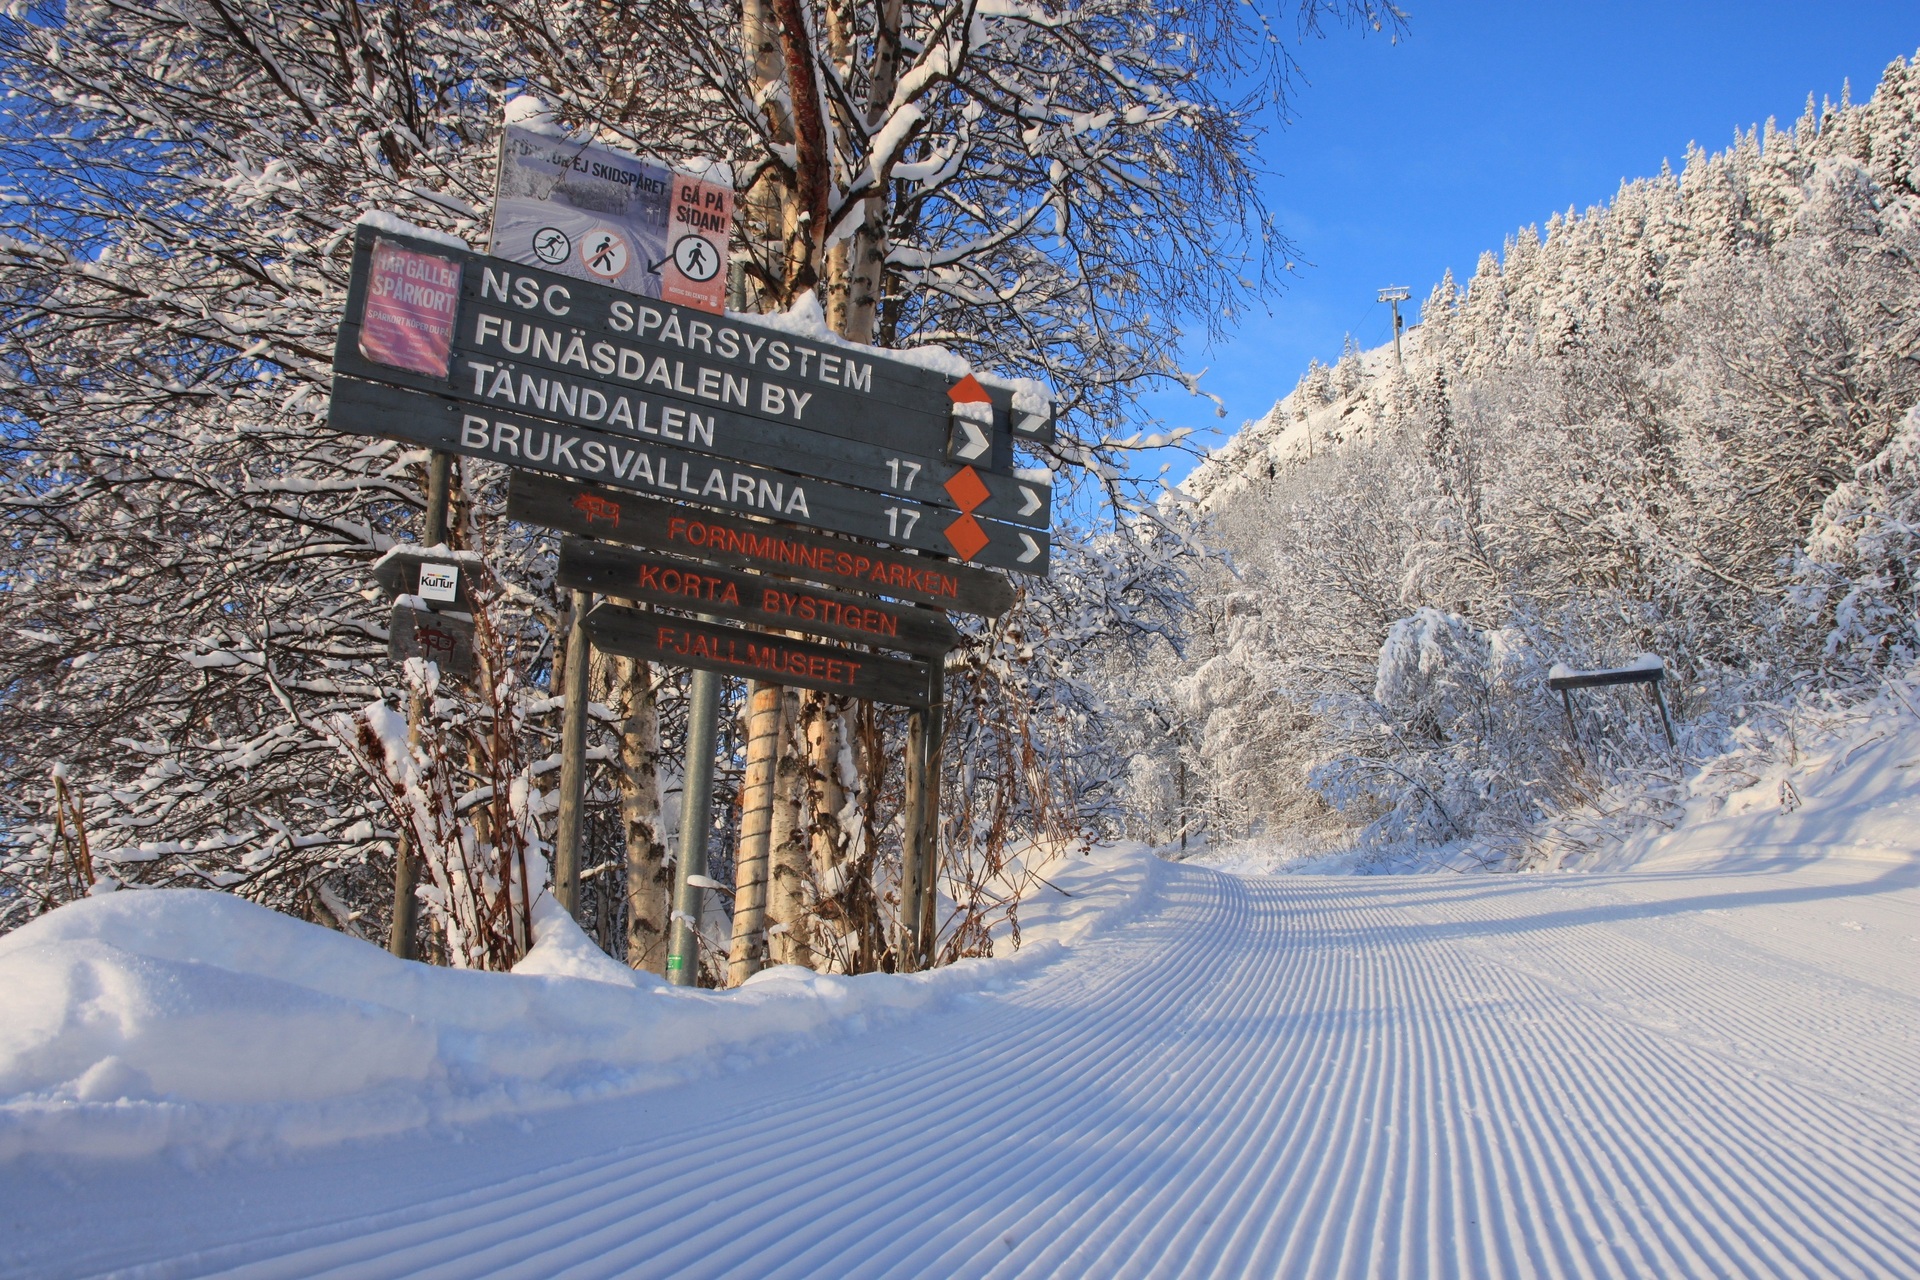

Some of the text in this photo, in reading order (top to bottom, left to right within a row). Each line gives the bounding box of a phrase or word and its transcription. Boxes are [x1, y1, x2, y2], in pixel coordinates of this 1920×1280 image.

[573, 157, 589, 173] EJ
[592, 162, 667, 196] SKIDSPÅRET
[681, 185, 724, 212] GÅ PÅ
[676, 205, 725, 233] SIDAN!
[372, 276, 455, 314] SPÅRKORT
[406, 259, 458, 288] GÄLLER
[367, 309, 406, 326] SPÅRKORT
[406, 317, 429, 332] KÖPER
[429, 324, 440, 335] DU
[480, 267, 873, 393] NSC SPÅRSYSTEM
[475, 313, 812, 419] FUNÄSDALEN BY
[468, 361, 922, 491] TÄNNDALEN 17
[460, 414, 920, 540] BRUKSVALLARNA 17
[667, 517, 958, 598] FORNMINNESPARKEN
[639, 564, 897, 638] KORTA BYSTIGEN
